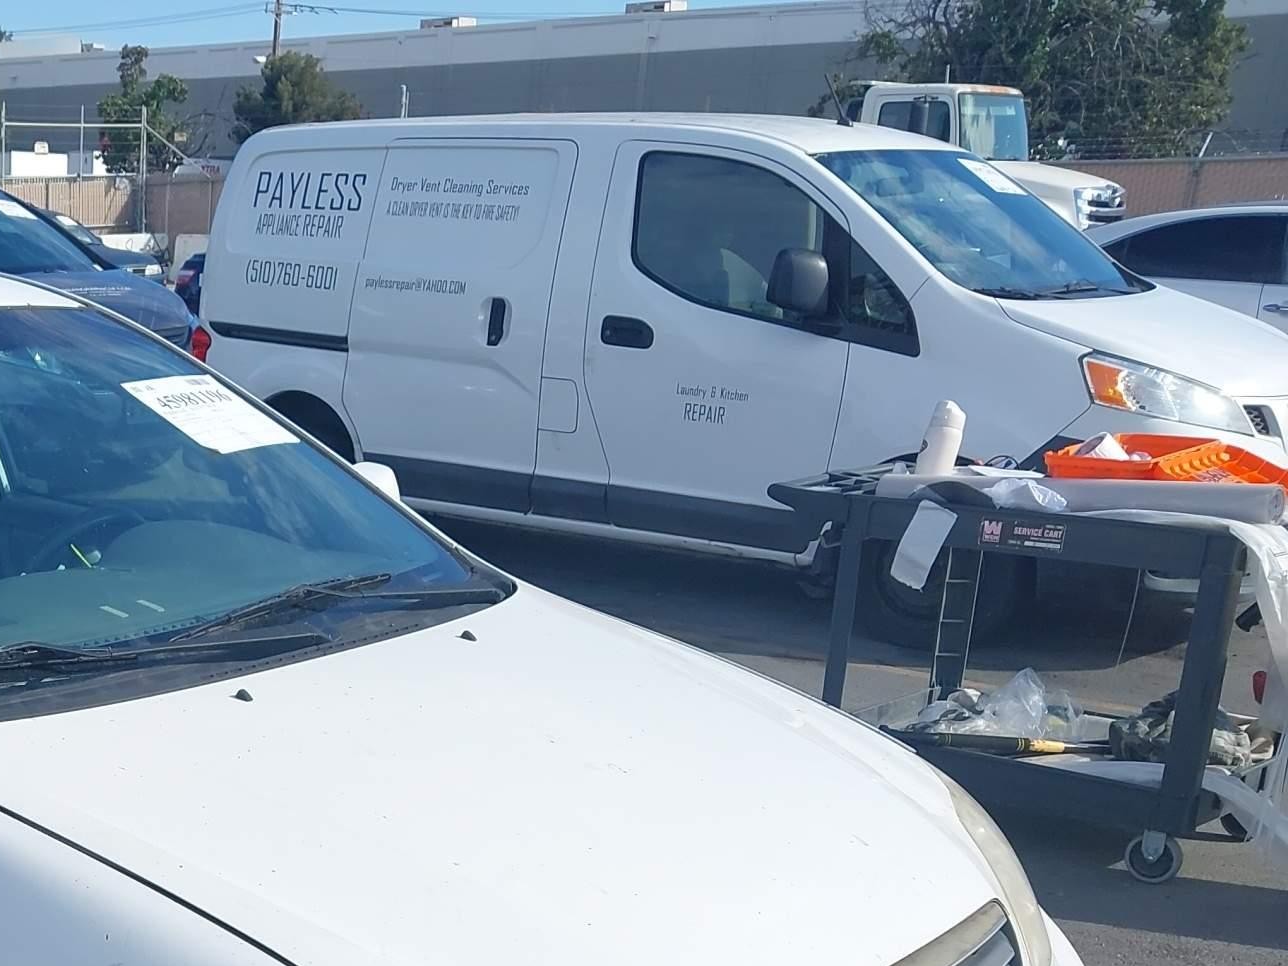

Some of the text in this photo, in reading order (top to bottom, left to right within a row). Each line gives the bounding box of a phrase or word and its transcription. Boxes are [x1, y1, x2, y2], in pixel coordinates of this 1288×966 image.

[253, 171, 367, 211] PAYLESS
[391, 176, 530, 197] Dryer Vent Cleaning Services
[386, 200, 392, 216] A
[391, 200, 410, 217] CLEAN
[429, 201, 443, 219] VENT
[451, 203, 462, 220] THE
[462, 203, 474, 220] KEY
[474, 203, 483, 221] TO
[256, 213, 344, 239] APPLIANCE REPAIR
[245, 259, 338, 291] (510)760-6001
[157, 389, 232, 411] 45981196
[676, 382, 707, 400] Laundry
[720, 386, 749, 401] Kitchen
[683, 402, 726, 425] REPAIR
[1014, 526, 1043, 537] SERVICE
[1044, 528, 1064, 539] CART
